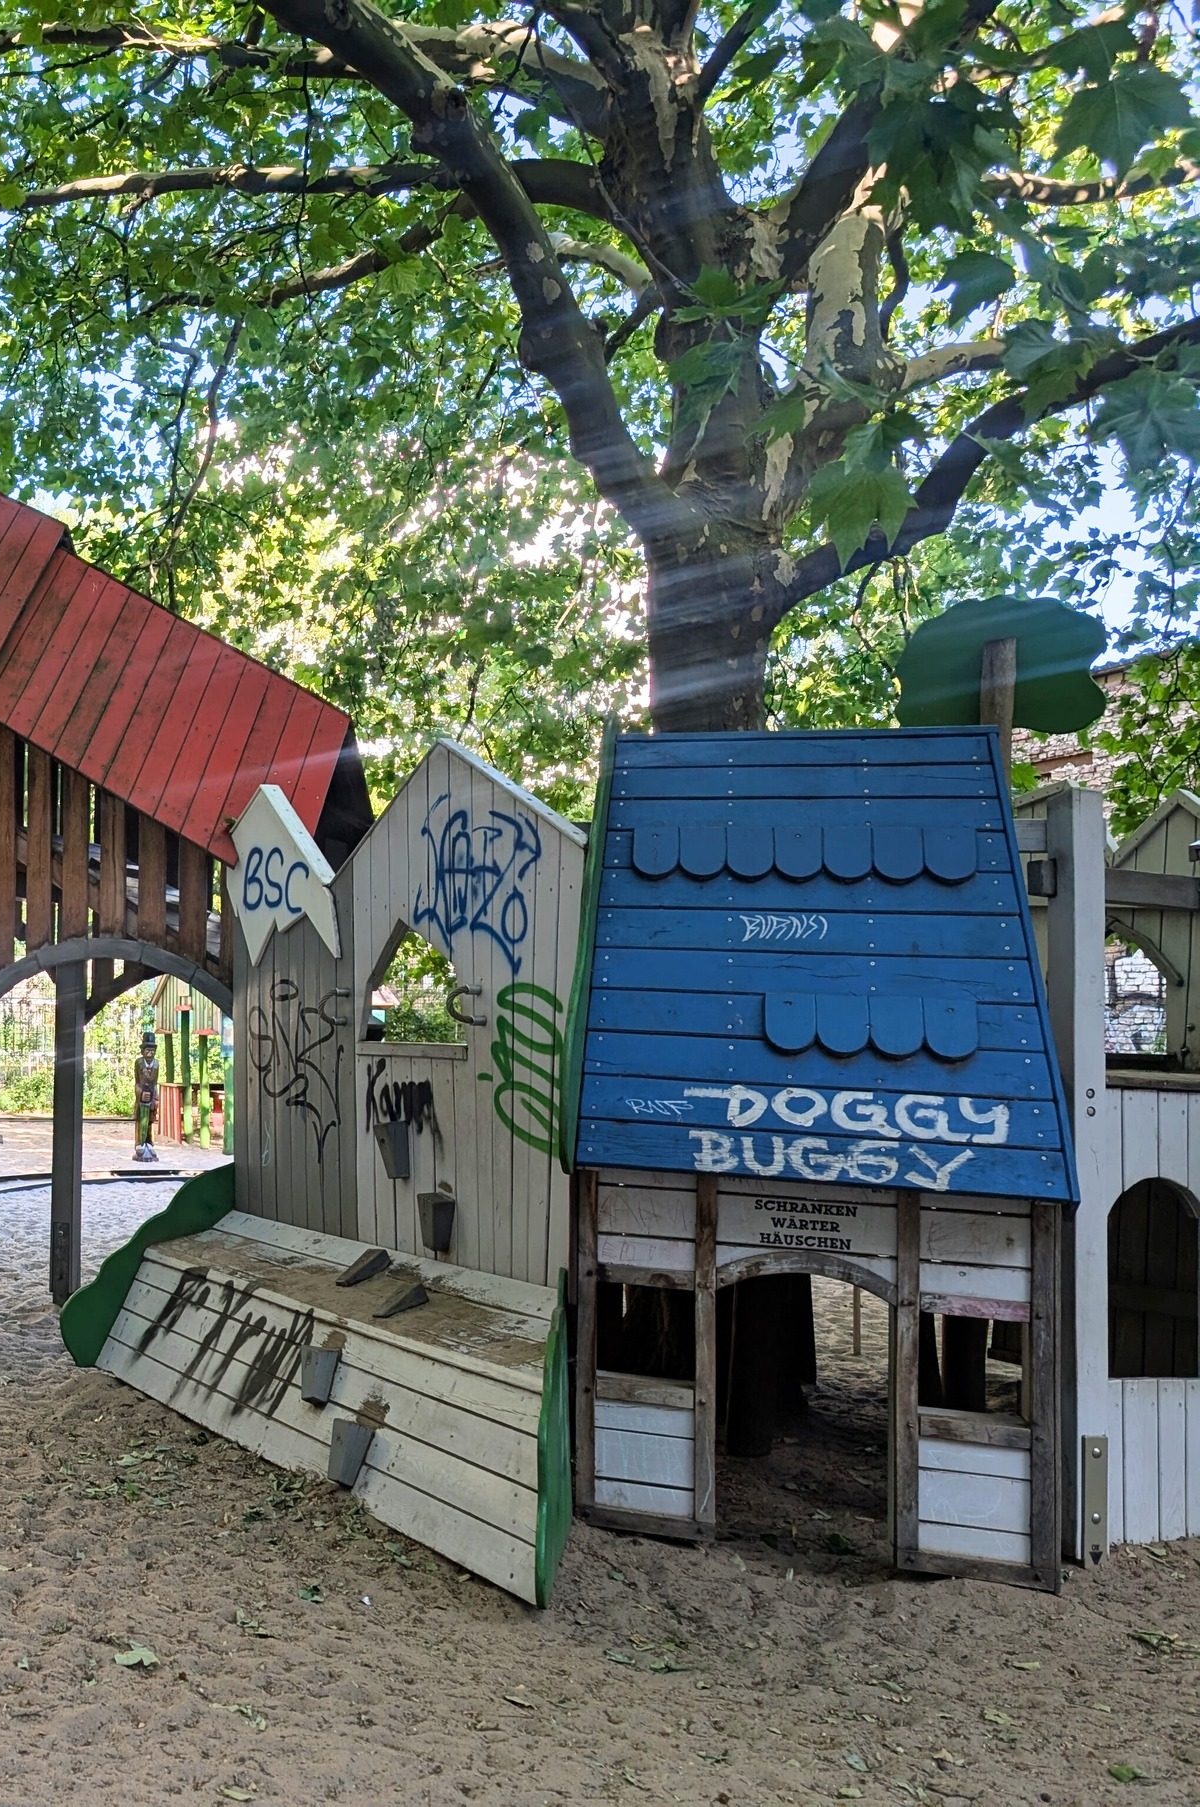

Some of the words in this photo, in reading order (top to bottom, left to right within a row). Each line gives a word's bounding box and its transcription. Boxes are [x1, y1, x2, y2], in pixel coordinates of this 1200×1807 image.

[243, 847, 309, 914] BSC
[684, 1085, 1010, 1144] DOGGY
[689, 1130, 975, 1191] BUGGY
[754, 1199, 858, 1218] SCHRANKEN
[771, 1216, 840, 1232] WÄRTER
[760, 1232, 853, 1250] HÄUSCHEN
